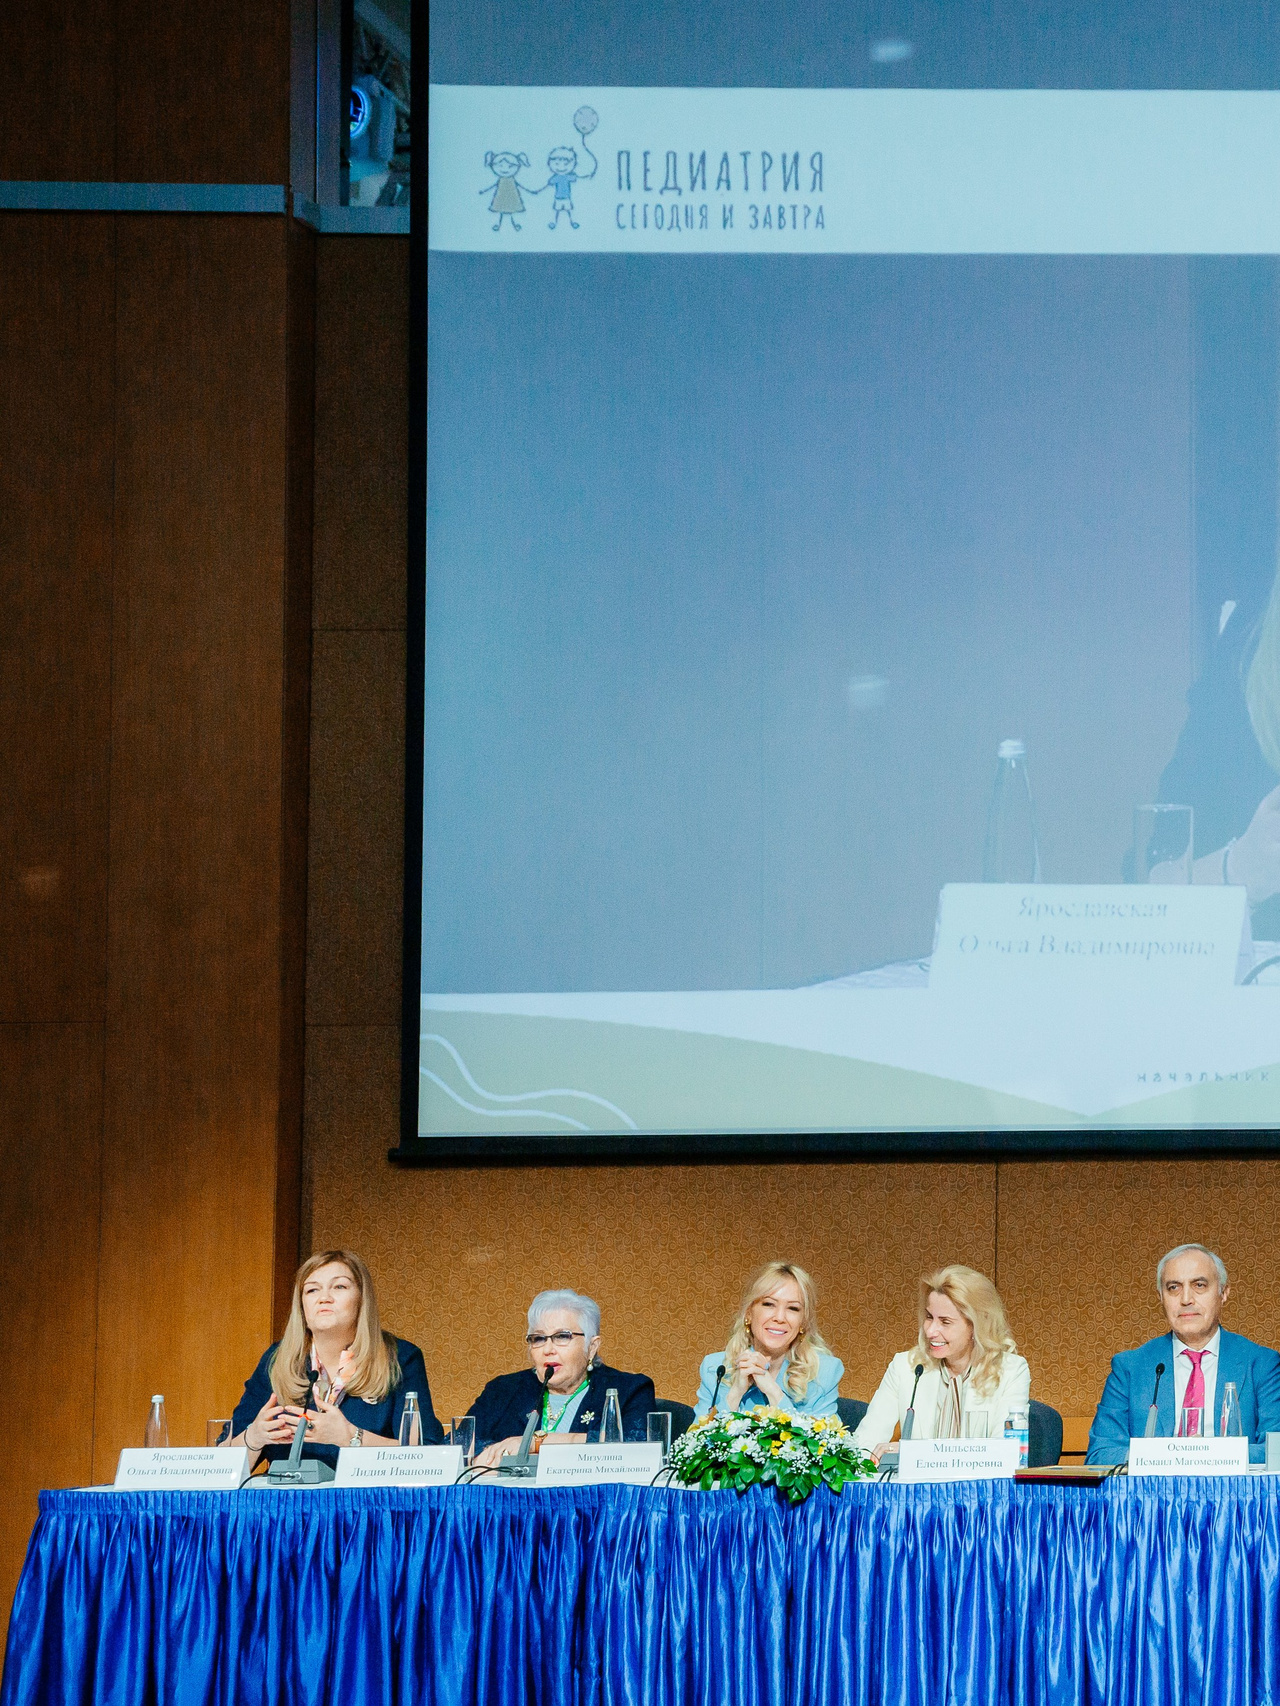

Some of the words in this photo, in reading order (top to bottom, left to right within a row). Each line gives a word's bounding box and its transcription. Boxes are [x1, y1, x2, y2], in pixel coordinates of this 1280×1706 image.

[616, 150, 824, 195] ПЕДИАТРИЯ
[615, 203, 708, 232] СЕГОДНЯ
[722, 203, 734, 230] И
[749, 203, 826, 231] ЗАВТРА
[1137, 1071, 1269, 1082] начальник
[933, 1443, 987, 1453] Мильская
[1167, 1443, 1210, 1451] Османов
[151, 1452, 214, 1463] Ярославская
[376, 1451, 424, 1461] Ильенко
[577, 1453, 623, 1463] Мизулина
[916, 1459, 948, 1469] Елена
[951, 1459, 1003, 1469] Игоревна
[1135, 1457, 1172, 1466] Исмаил
[1174, 1457, 1240, 1466] Магомедович
[127, 1467, 157, 1476] Ольга
[159, 1466, 233, 1477] Владимировна
[351, 1467, 387, 1477] Лидия
[389, 1467, 443, 1476] Ивановна
[546, 1467, 592, 1476] Екатерина
[595, 1466, 651, 1474] Михайловна
